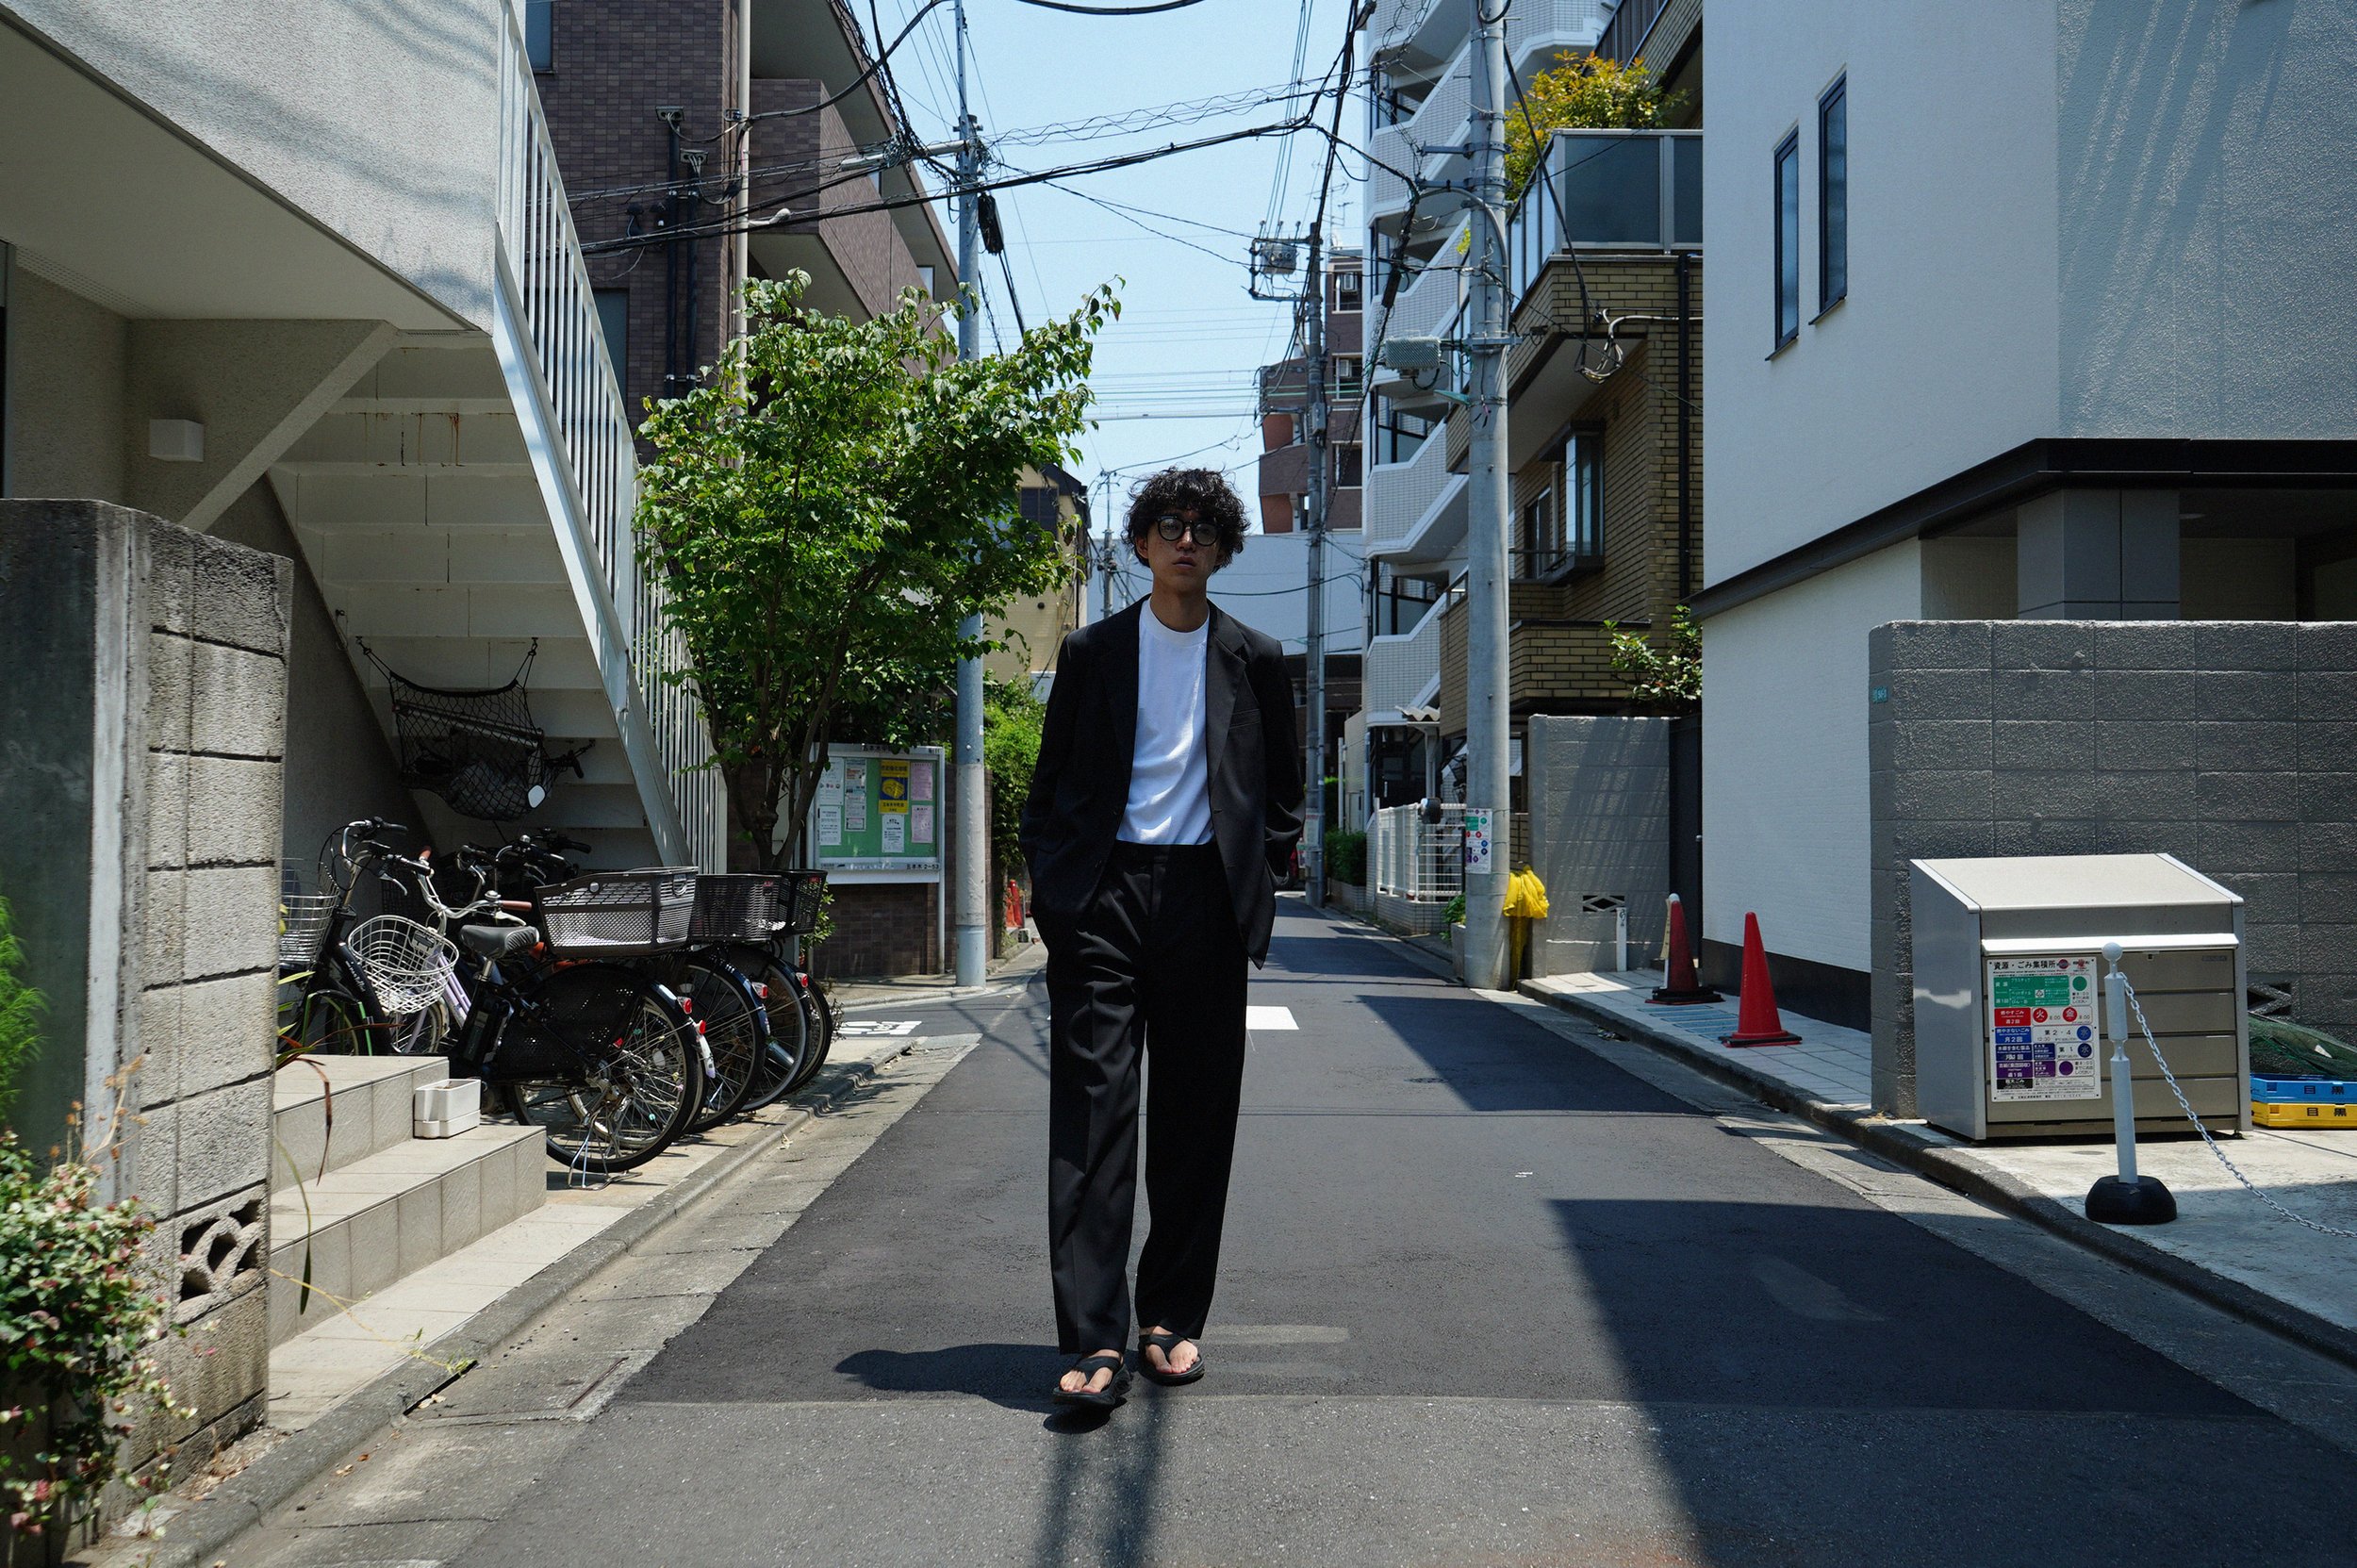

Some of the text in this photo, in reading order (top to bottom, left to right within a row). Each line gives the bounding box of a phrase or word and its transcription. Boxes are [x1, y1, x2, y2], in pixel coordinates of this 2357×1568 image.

[1993, 960, 2056, 970] 資源・ごみ集積所
[2036, 1010, 2045, 1018] 火
[2066, 1009, 2074, 1017] 金
[2303, 1085, 2345, 1095] 目黒
[2306, 1107, 2347, 1116] 目黒
